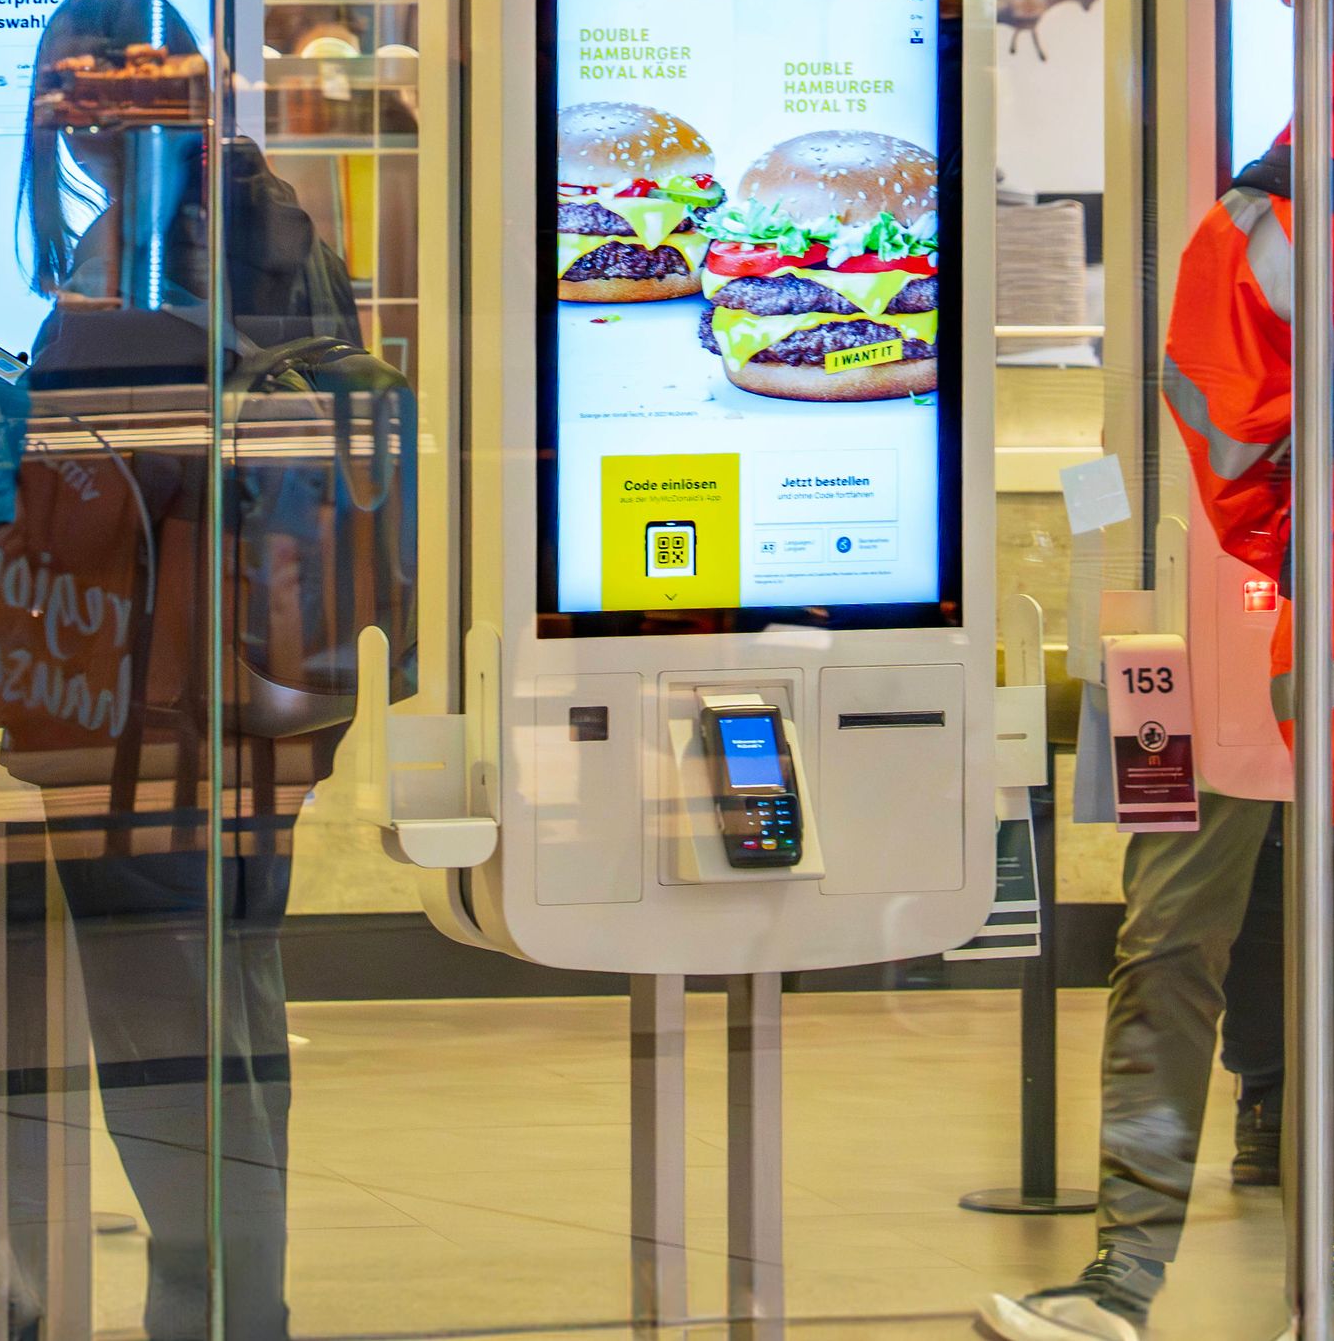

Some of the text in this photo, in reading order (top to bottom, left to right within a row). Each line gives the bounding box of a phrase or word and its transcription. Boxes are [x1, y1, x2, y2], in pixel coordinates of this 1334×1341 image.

[579, 28, 650, 42] DOUBLE
[579, 46, 691, 60] HAMBURGER
[579, 61, 687, 79] ROYAL KÄSE
[784, 62, 854, 76] DOUBLE
[784, 80, 894, 94] HAMBURGER
[784, 98, 867, 112] ROYAL TS
[841, 349, 877, 366] WANT
[881, 345, 893, 358] IT
[624, 478, 717, 491] Code einlösen
[781, 476, 870, 488] Jetzt bestellen
[1122, 666, 1174, 694] 153
